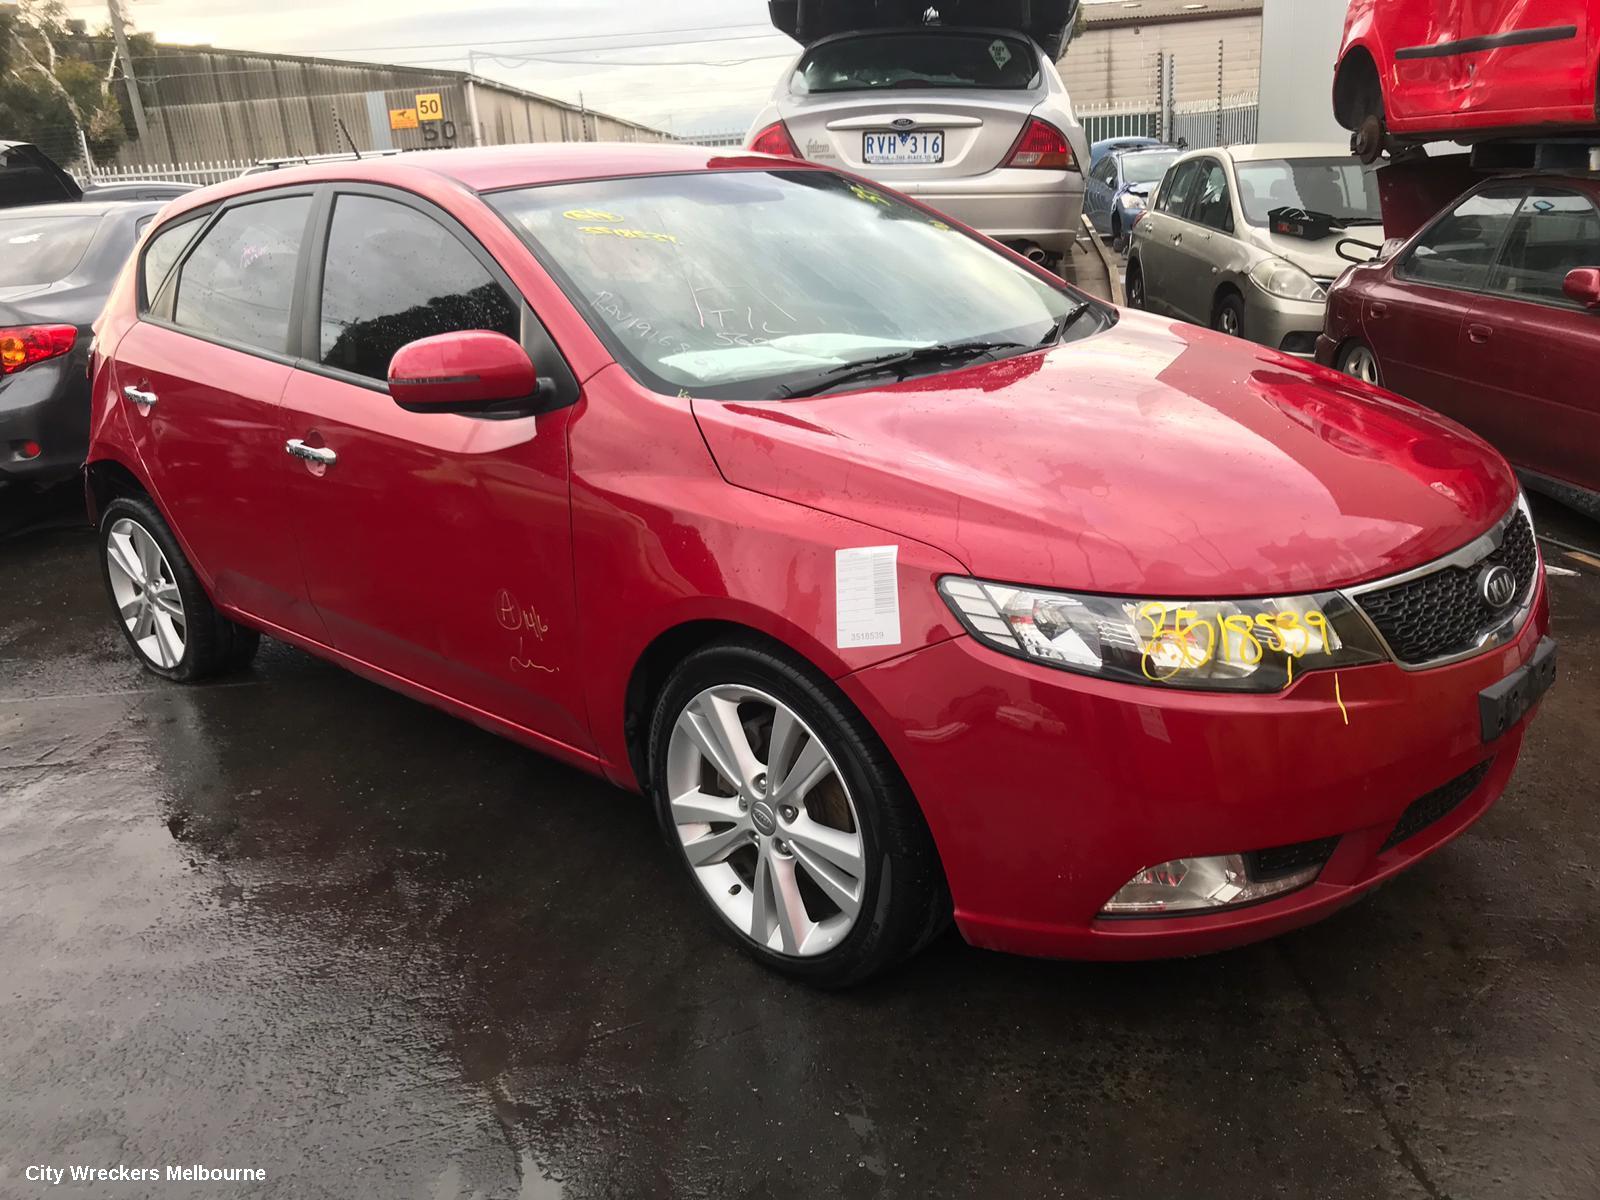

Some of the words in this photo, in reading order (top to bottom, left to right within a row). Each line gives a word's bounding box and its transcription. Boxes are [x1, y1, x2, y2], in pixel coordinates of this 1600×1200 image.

[420, 99, 439, 114] 50
[422, 120, 456, 141] 50
[866, 136, 896, 154] RVH
[910, 136, 940, 154] 316
[1489, 573, 1513, 601] KIA
